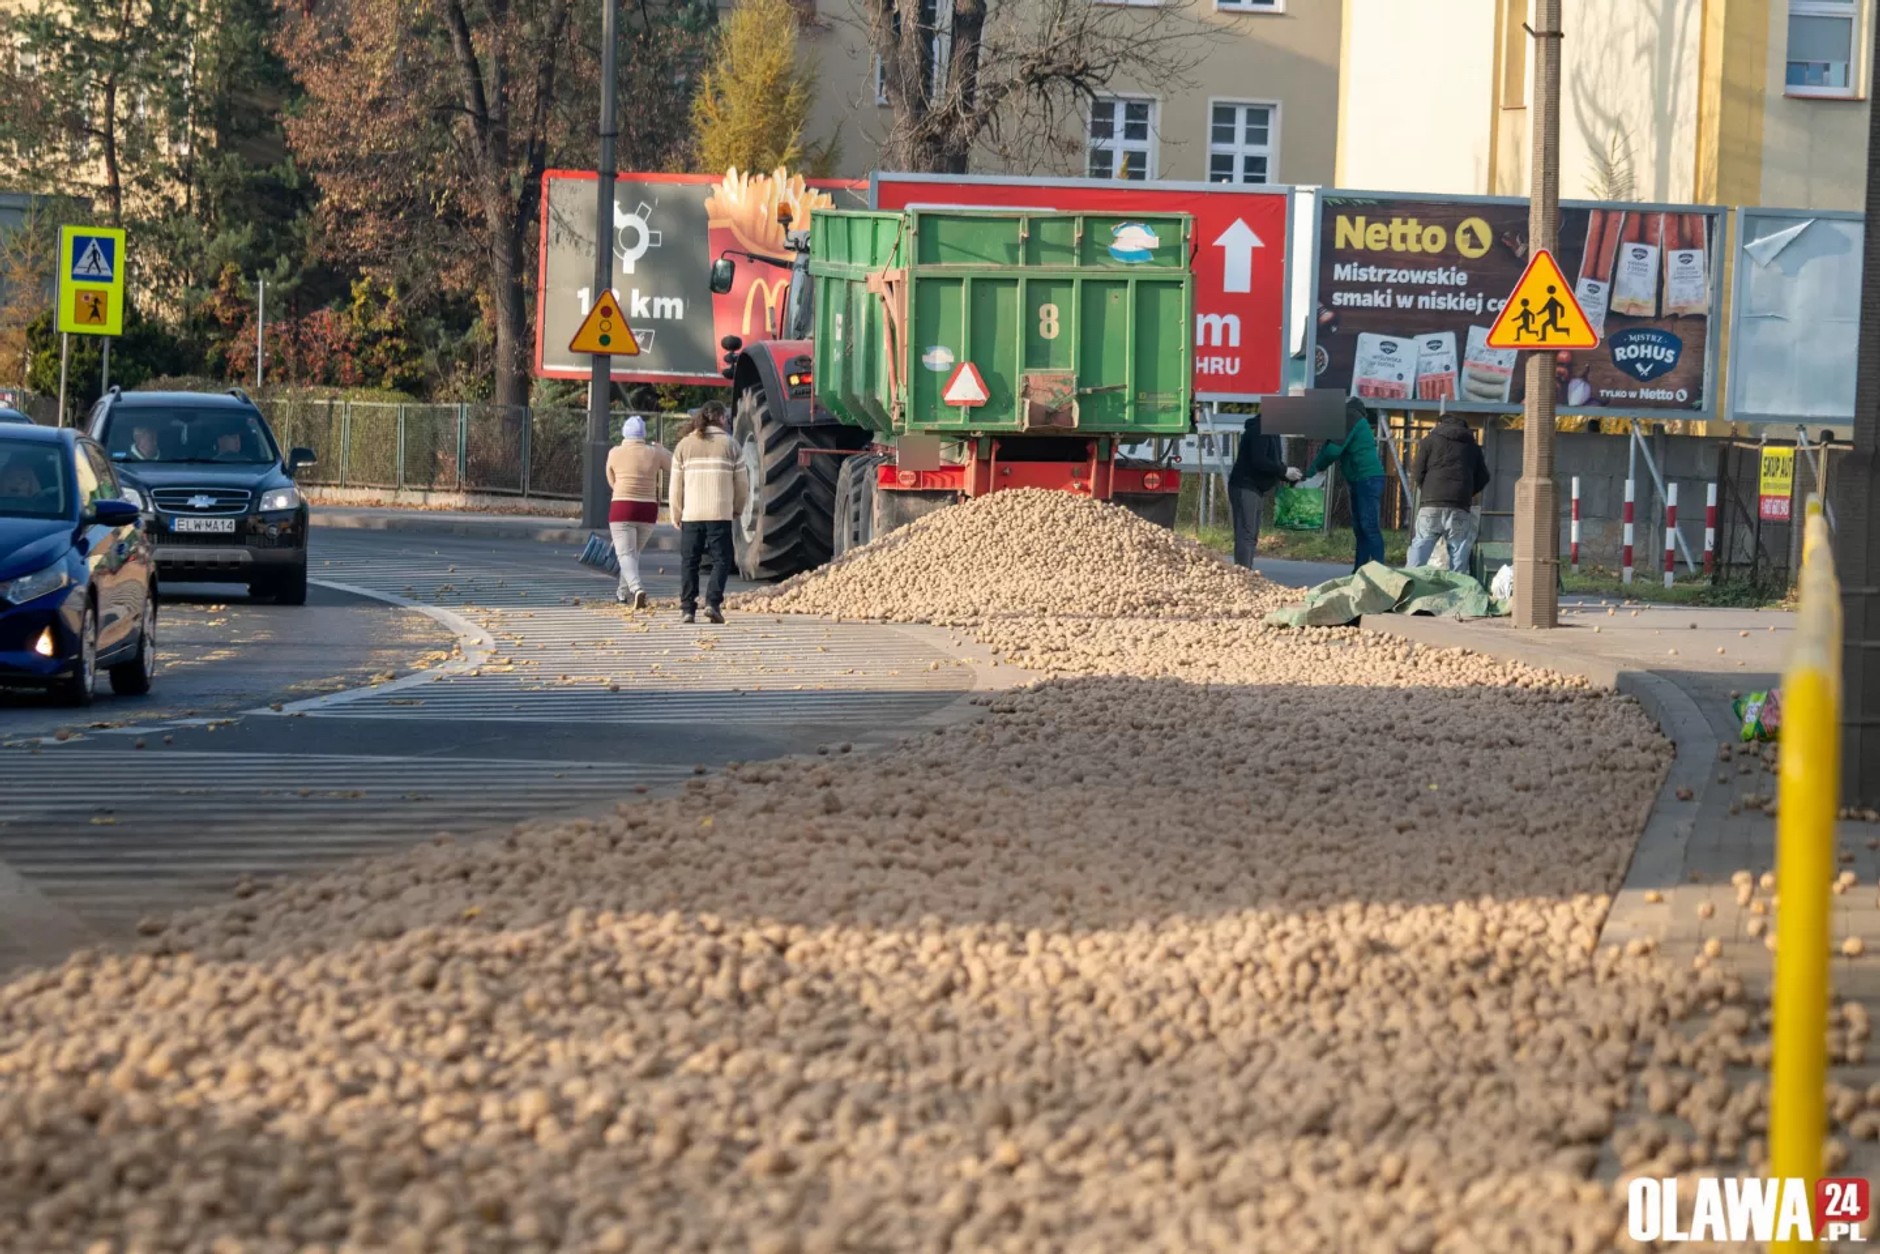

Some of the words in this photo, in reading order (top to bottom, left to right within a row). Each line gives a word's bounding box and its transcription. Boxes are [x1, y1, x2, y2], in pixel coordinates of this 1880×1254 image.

[1335, 215, 1447, 254] Netto
[1333, 262, 1468, 286] Mistrzowskie
[630, 288, 684, 320] km
[1332, 289, 1392, 309] smaki
[1396, 294, 1414, 309] w
[1418, 291, 1483, 316] niskiej
[1486, 298, 1507, 313] ce
[1039, 303, 1060, 340] 8
[1196, 313, 1241, 348] m
[1628, 333, 1664, 344] MISTRZ
[1196, 356, 1241, 376] HRU
[1614, 344, 1676, 364] ROHUS
[1600, 389, 1627, 398] TYLKO
[1639, 388, 1674, 400] Netto
